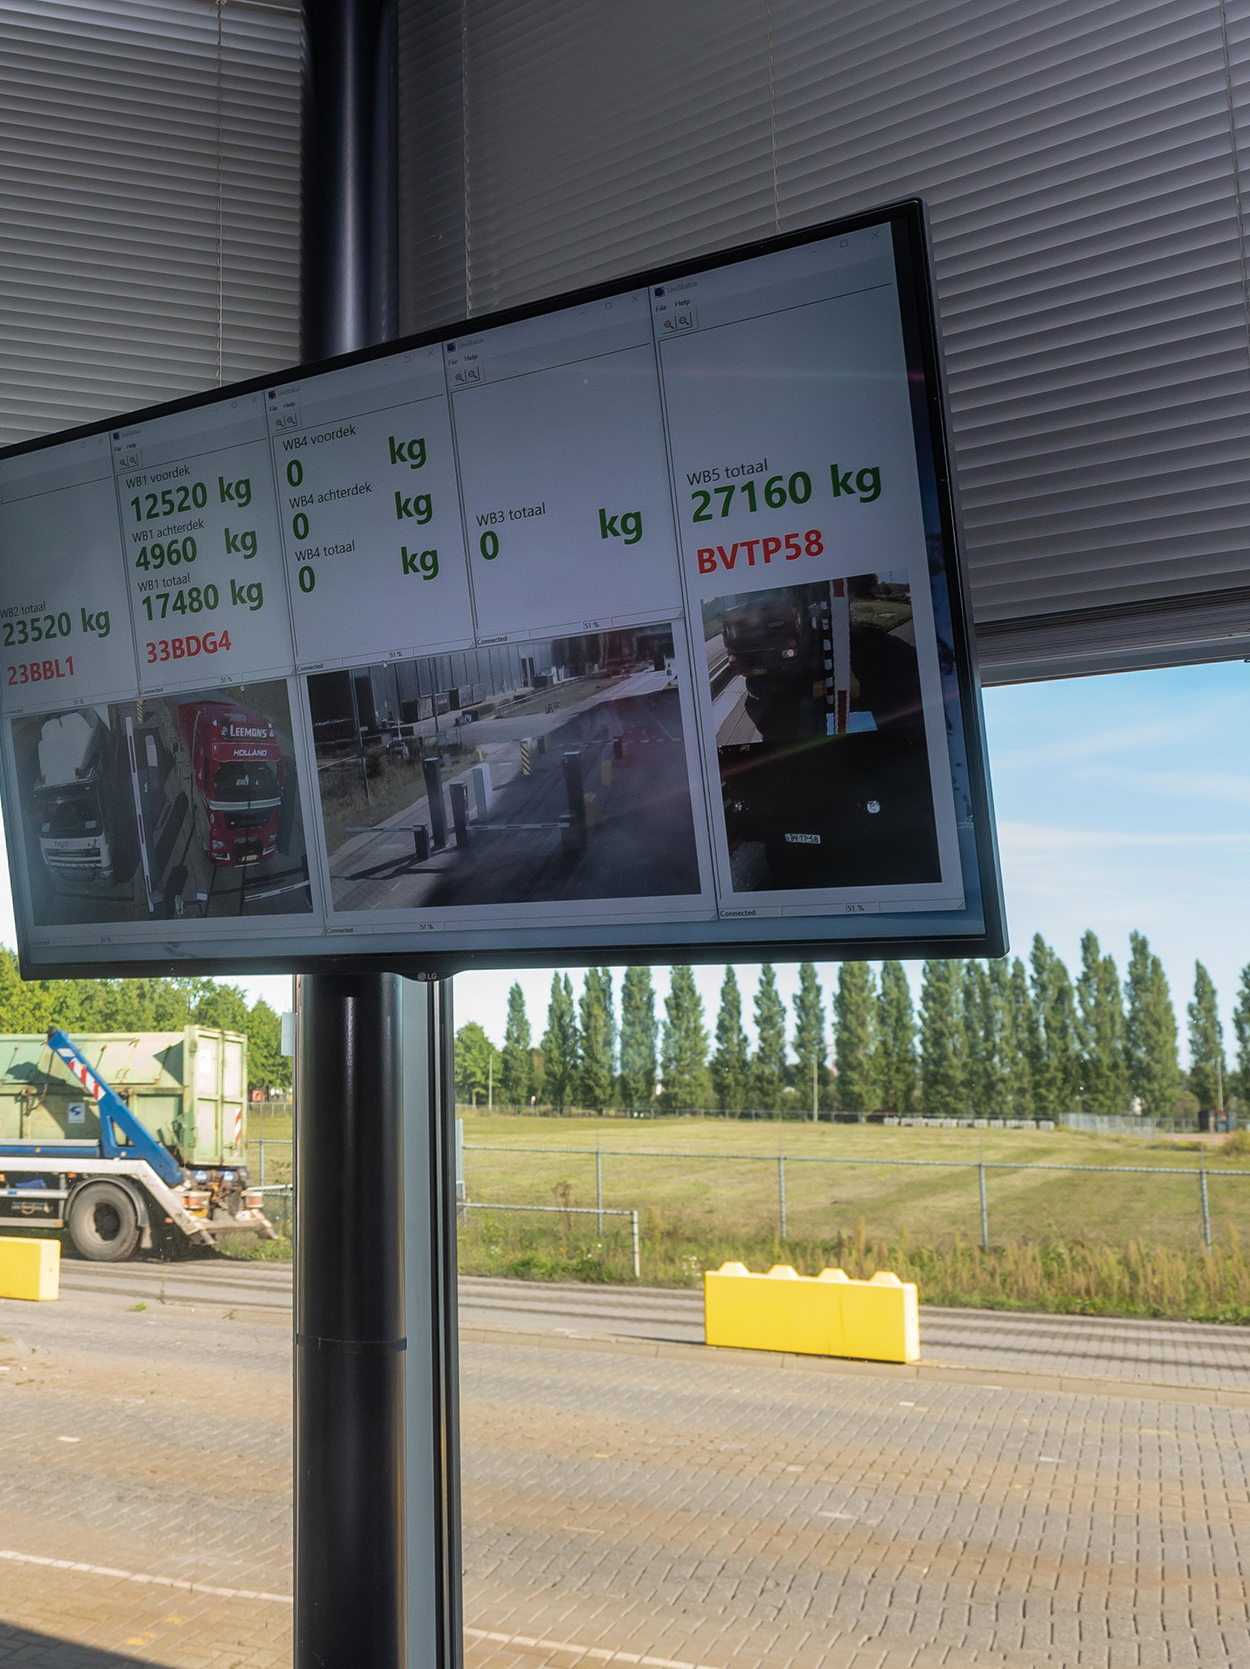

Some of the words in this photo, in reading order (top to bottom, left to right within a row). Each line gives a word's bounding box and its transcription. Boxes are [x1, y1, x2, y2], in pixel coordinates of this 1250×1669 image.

[674, 299, 691, 308] Help
[283, 401, 295, 409] Help
[283, 435, 308, 451] WB4
[310, 424, 356, 446] voordek
[286, 459, 304, 487] 0
[388, 436, 427, 469] kg
[686, 467, 720, 486] WB5
[725, 458, 768, 479] totaal
[125, 475, 148, 490] WB1
[150, 464, 190, 485] voordek
[131, 481, 207, 522] 12520
[218, 476, 251, 508] kg
[289, 493, 315, 509] WB4
[317, 482, 372, 504] achterdek
[691, 471, 812, 523] 27160
[830, 463, 882, 503] kg
[292, 512, 310, 540] 0
[394, 491, 433, 525] kg
[476, 510, 505, 527] WB3
[509, 502, 546, 520] totaal
[132, 529, 153, 543] WB1
[156, 518, 204, 539] achterdek
[480, 530, 499, 560] 0
[598, 508, 643, 545] kg
[135, 536, 197, 571] 4960
[224, 528, 257, 559] kg
[295, 546, 320, 562] WB4
[323, 540, 356, 557] totaal
[697, 529, 824, 574] BVTP58
[137, 579, 160, 593] WB1
[161, 572, 190, 589] totaal
[298, 565, 316, 593] 0
[400, 546, 439, 581] kg
[0, 606, 19, 619] WB2
[21, 601, 46, 614] totaal
[142, 583, 219, 621] 17480
[230, 579, 263, 611] kg
[3, 612, 71, 647] 23520
[81, 608, 111, 638] kg
[476, 636, 508, 646] Connected
[146, 630, 231, 664] 33BDG4
[7, 656, 74, 686] 23BBL1
[297, 663, 324, 673] Connected
[230, 724, 267, 738] LEEMANS
[232, 749, 268, 757] HOLLAND
[720, 909, 756, 917] Connected
[427, 972, 437, 980] LG
